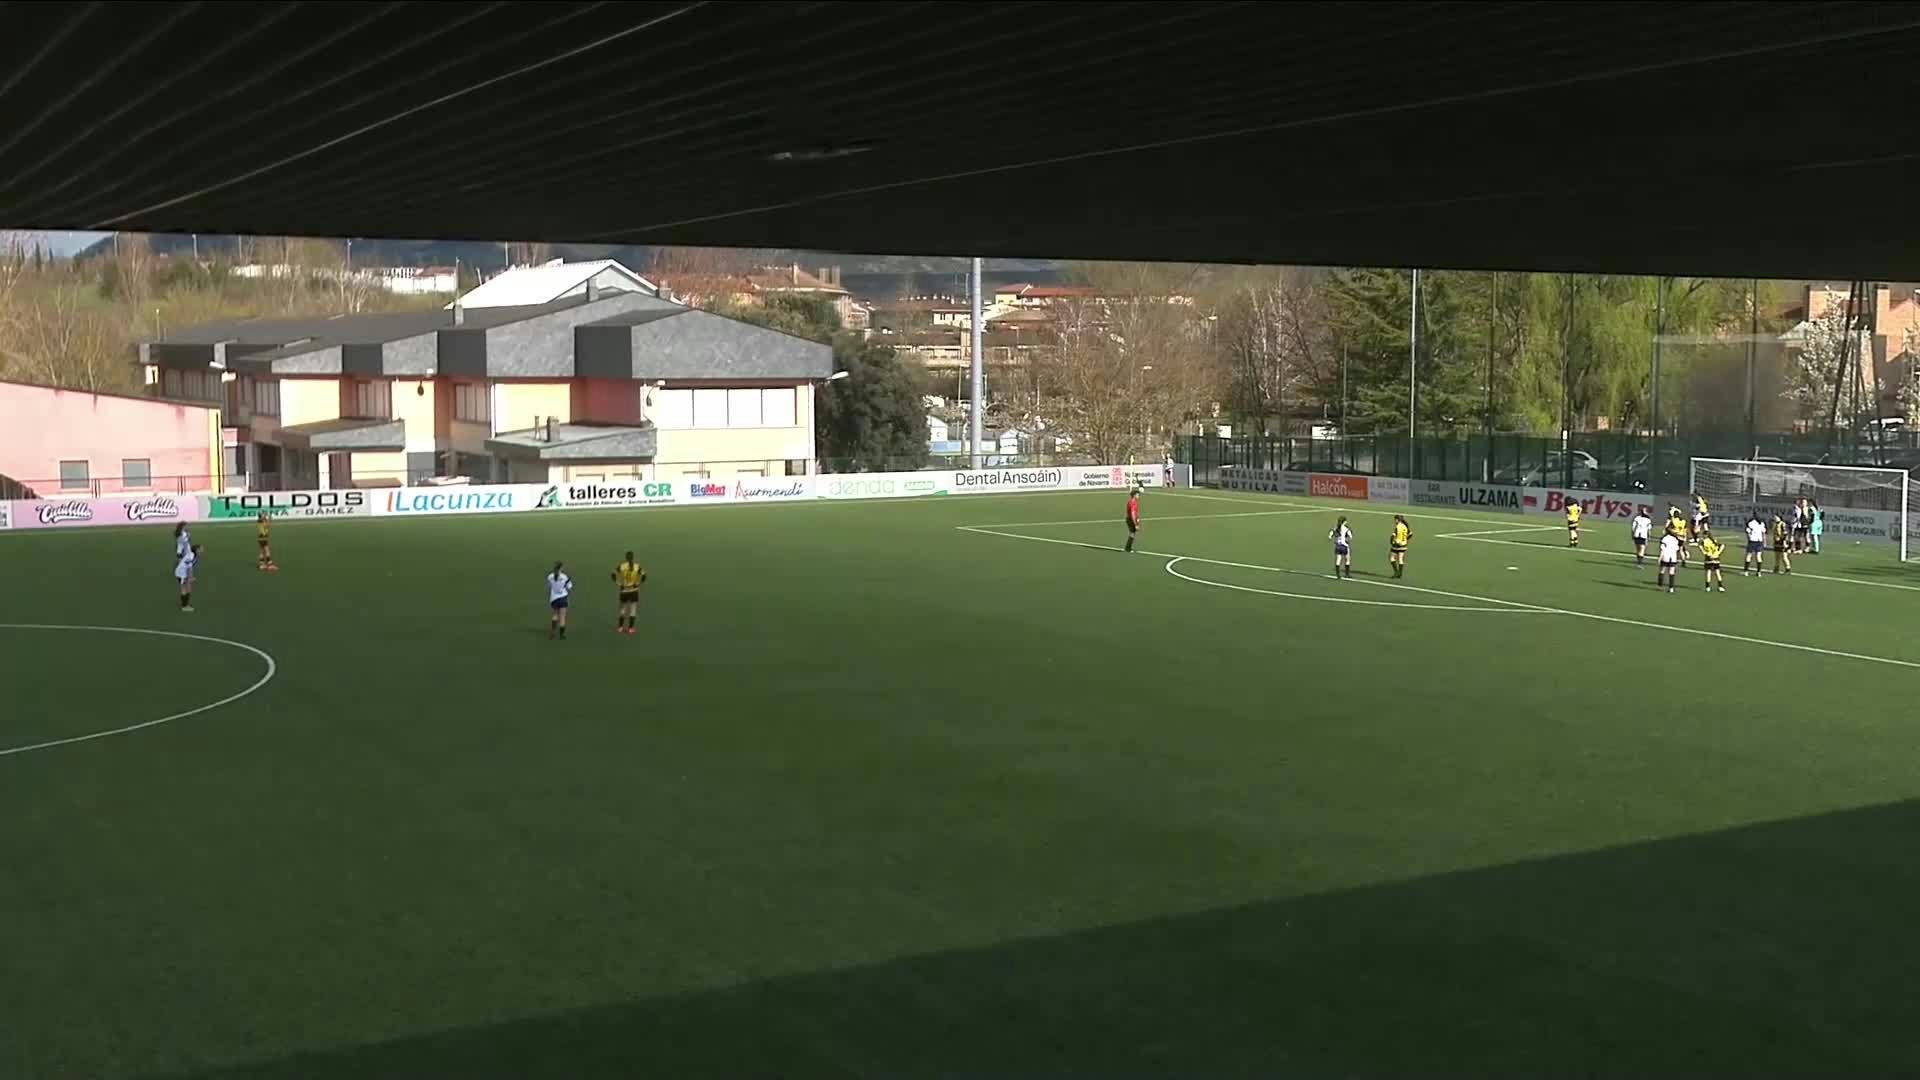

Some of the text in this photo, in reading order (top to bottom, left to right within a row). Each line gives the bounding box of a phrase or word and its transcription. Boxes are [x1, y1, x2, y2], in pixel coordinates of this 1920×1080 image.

[956, 471, 1000, 486] Dental
[1221, 480, 1279, 493] MUTILVA
[1312, 478, 1347, 496] Halcón
[569, 483, 672, 500] talleres CR
[690, 483, 726, 497] BigMat
[1459, 487, 1519, 508] ULZAMA
[217, 491, 364, 511] TOLDOS
[1544, 490, 1633, 519] Brlys
